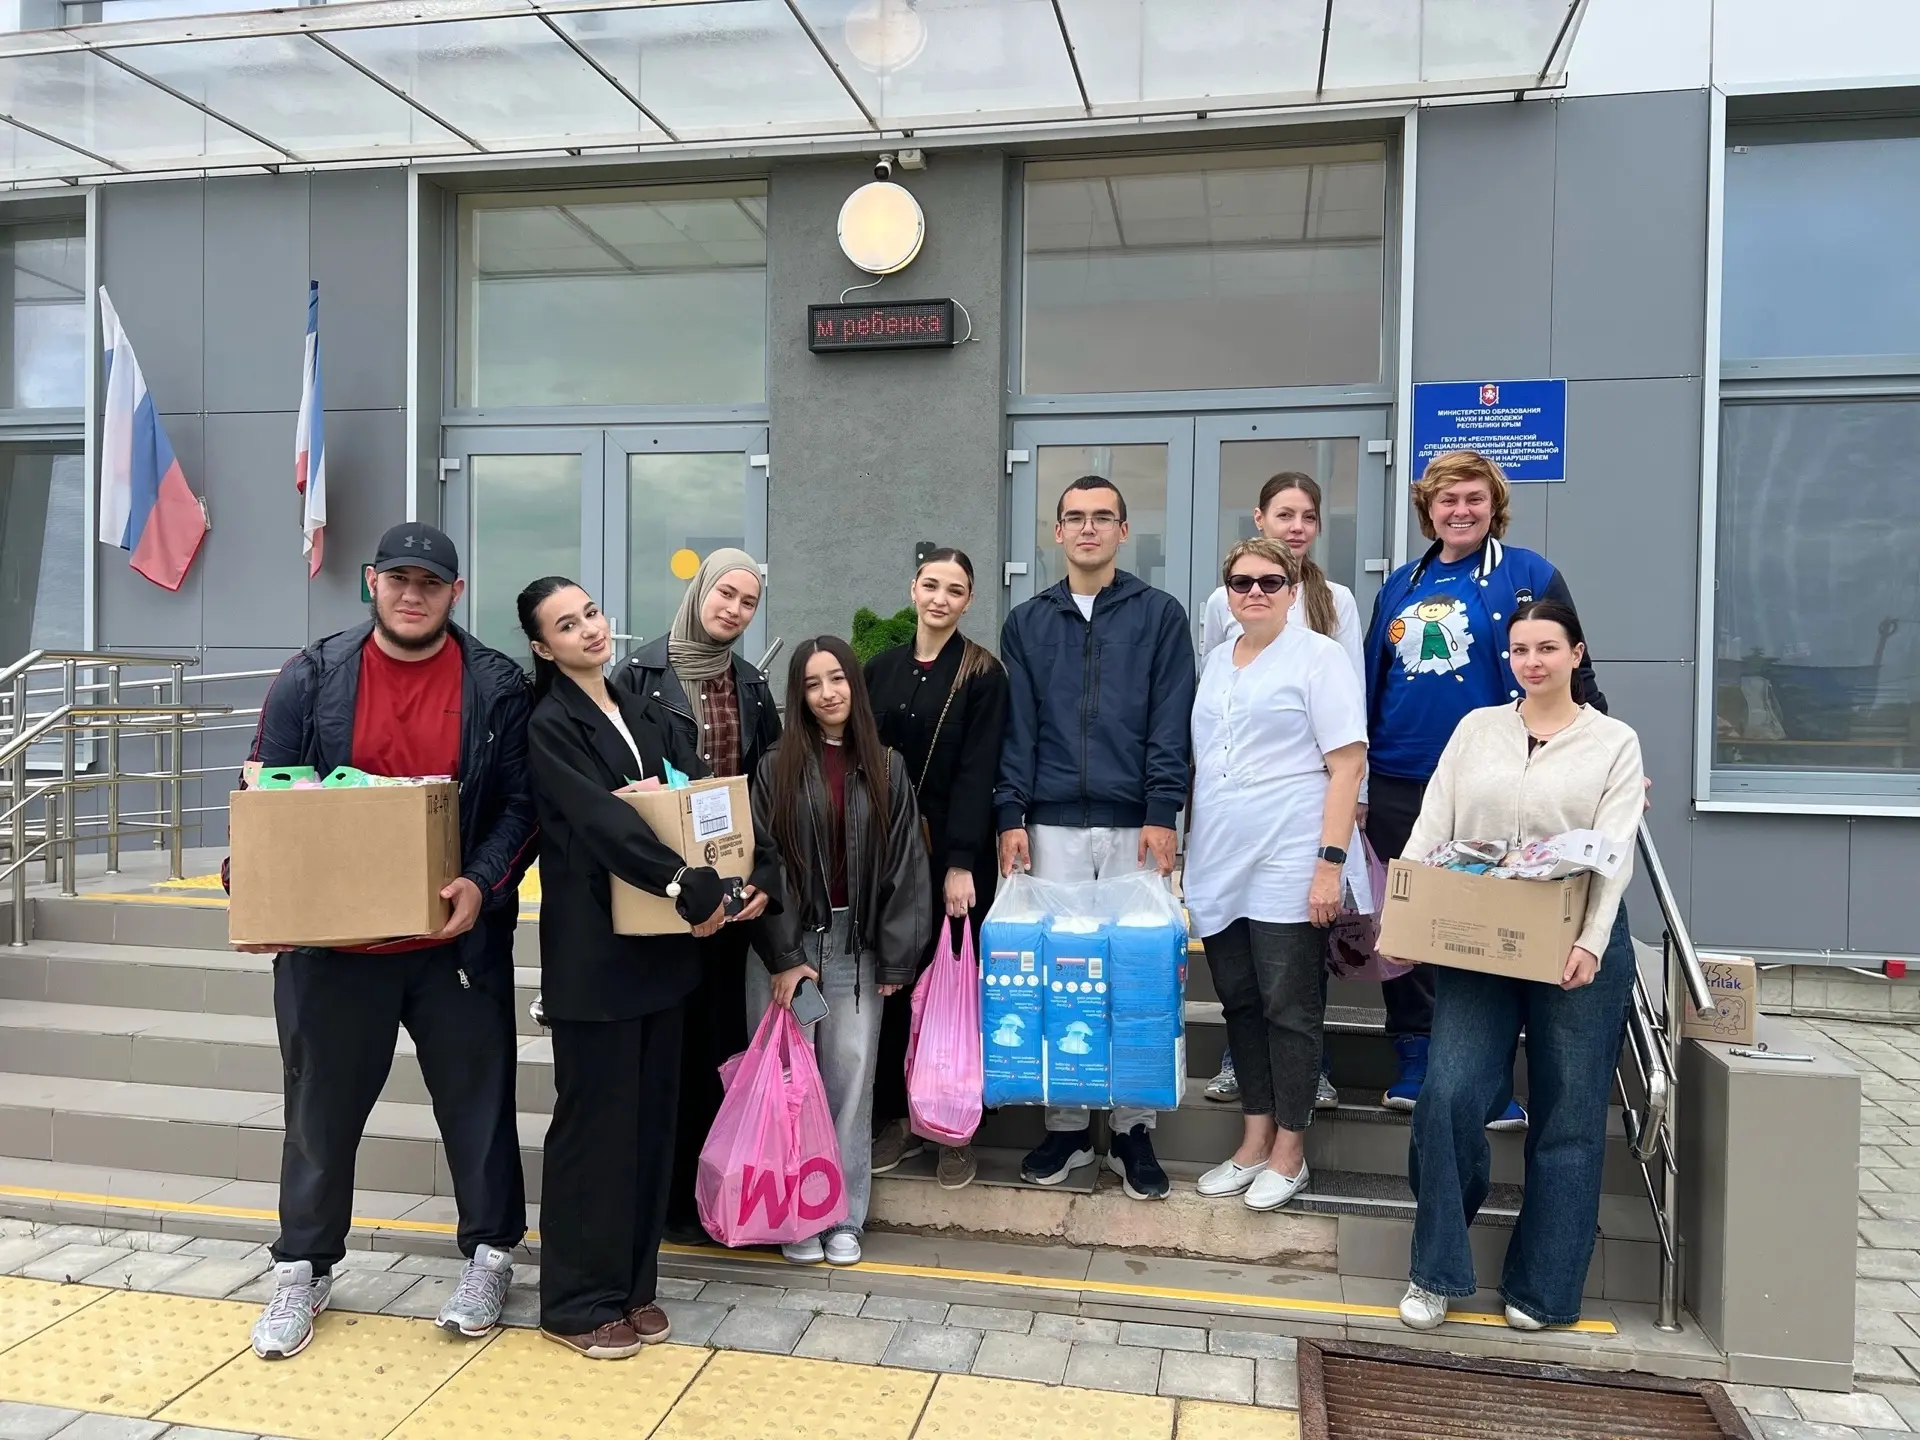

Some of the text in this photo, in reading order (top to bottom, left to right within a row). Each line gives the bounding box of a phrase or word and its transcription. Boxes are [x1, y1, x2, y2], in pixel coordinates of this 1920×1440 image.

[843, 312, 940, 341] ребенка
[1468, 434, 1537, 442] «РЕСПУБЛИКАНСКИЙ
[1424, 441, 1506, 450] СПЕЦИАЛИЗИРОВАННЫЙ
[1507, 441, 1522, 449] ДОМ
[1510, 447, 1559, 455] ЦЕНТРАЛЬНОЙ
